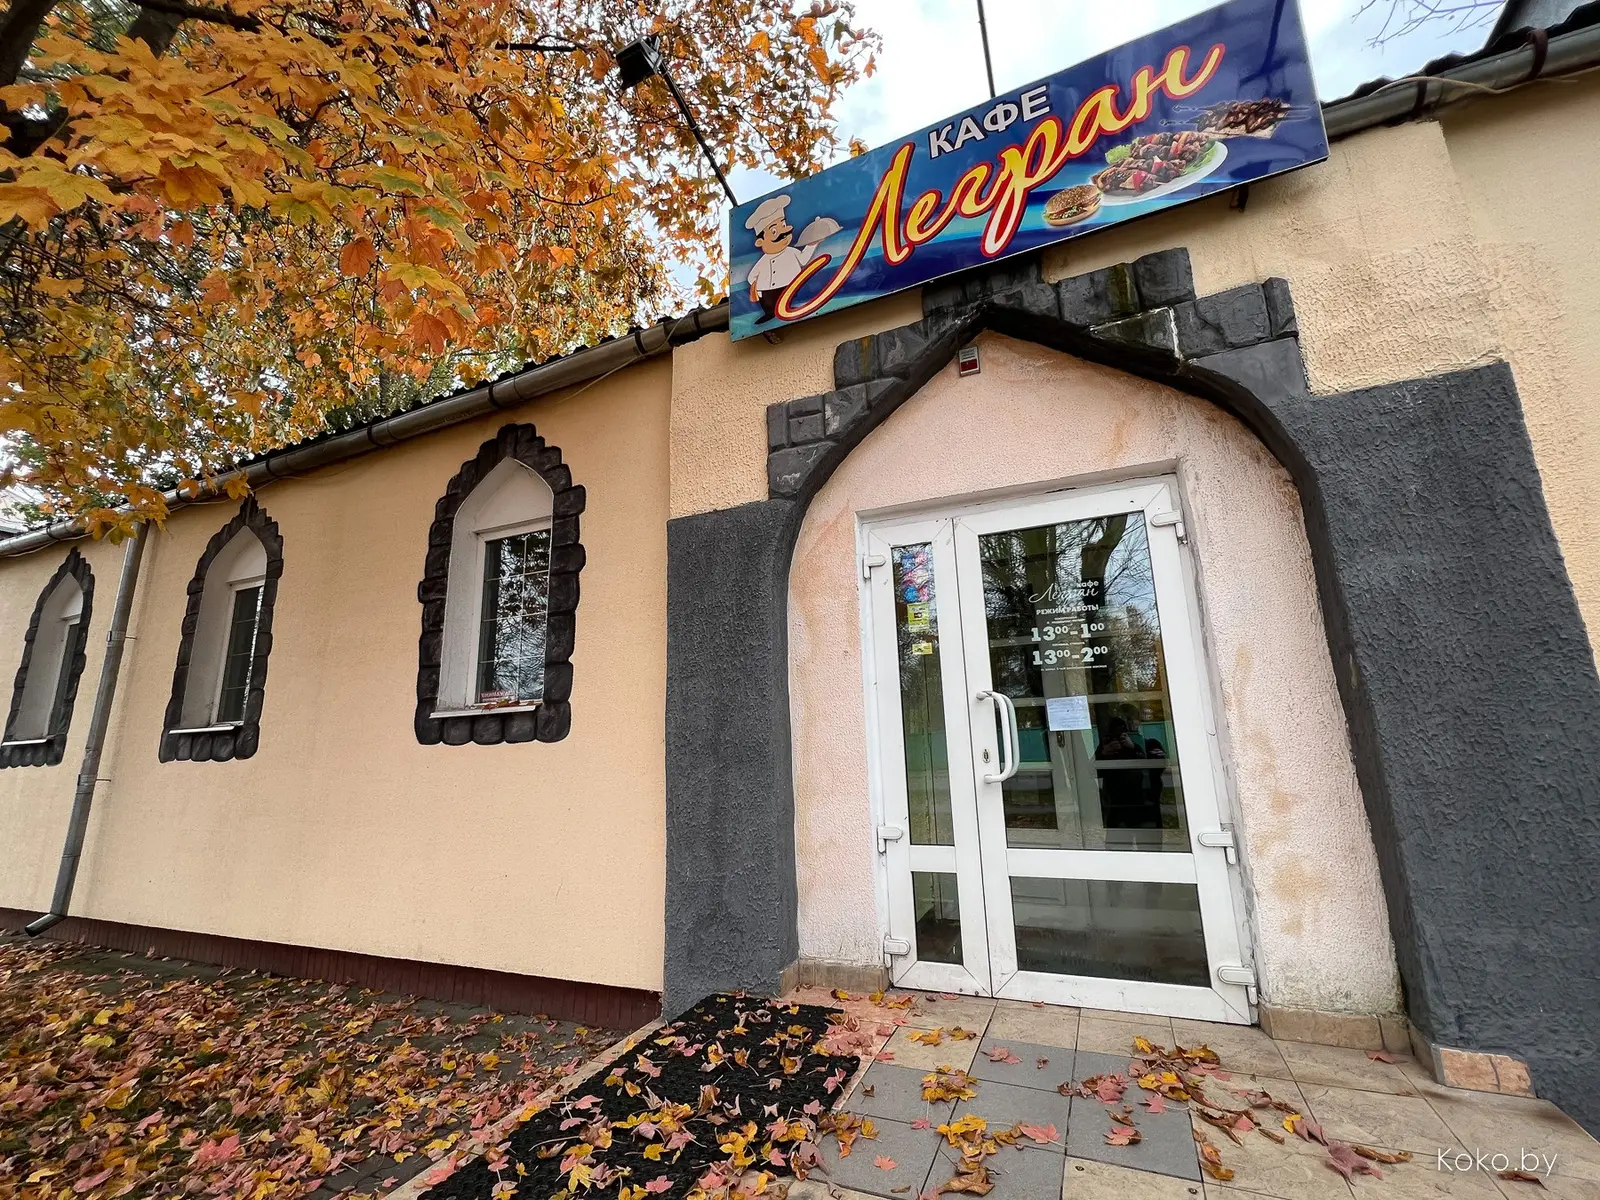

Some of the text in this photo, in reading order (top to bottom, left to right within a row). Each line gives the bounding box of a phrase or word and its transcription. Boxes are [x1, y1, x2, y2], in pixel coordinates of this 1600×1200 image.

[928, 85, 1050, 159] КАФЕ
[775, 43, 1226, 321] Легран
[1036, 604, 1099, 615] РЕЖИМ РАБОТЫ
